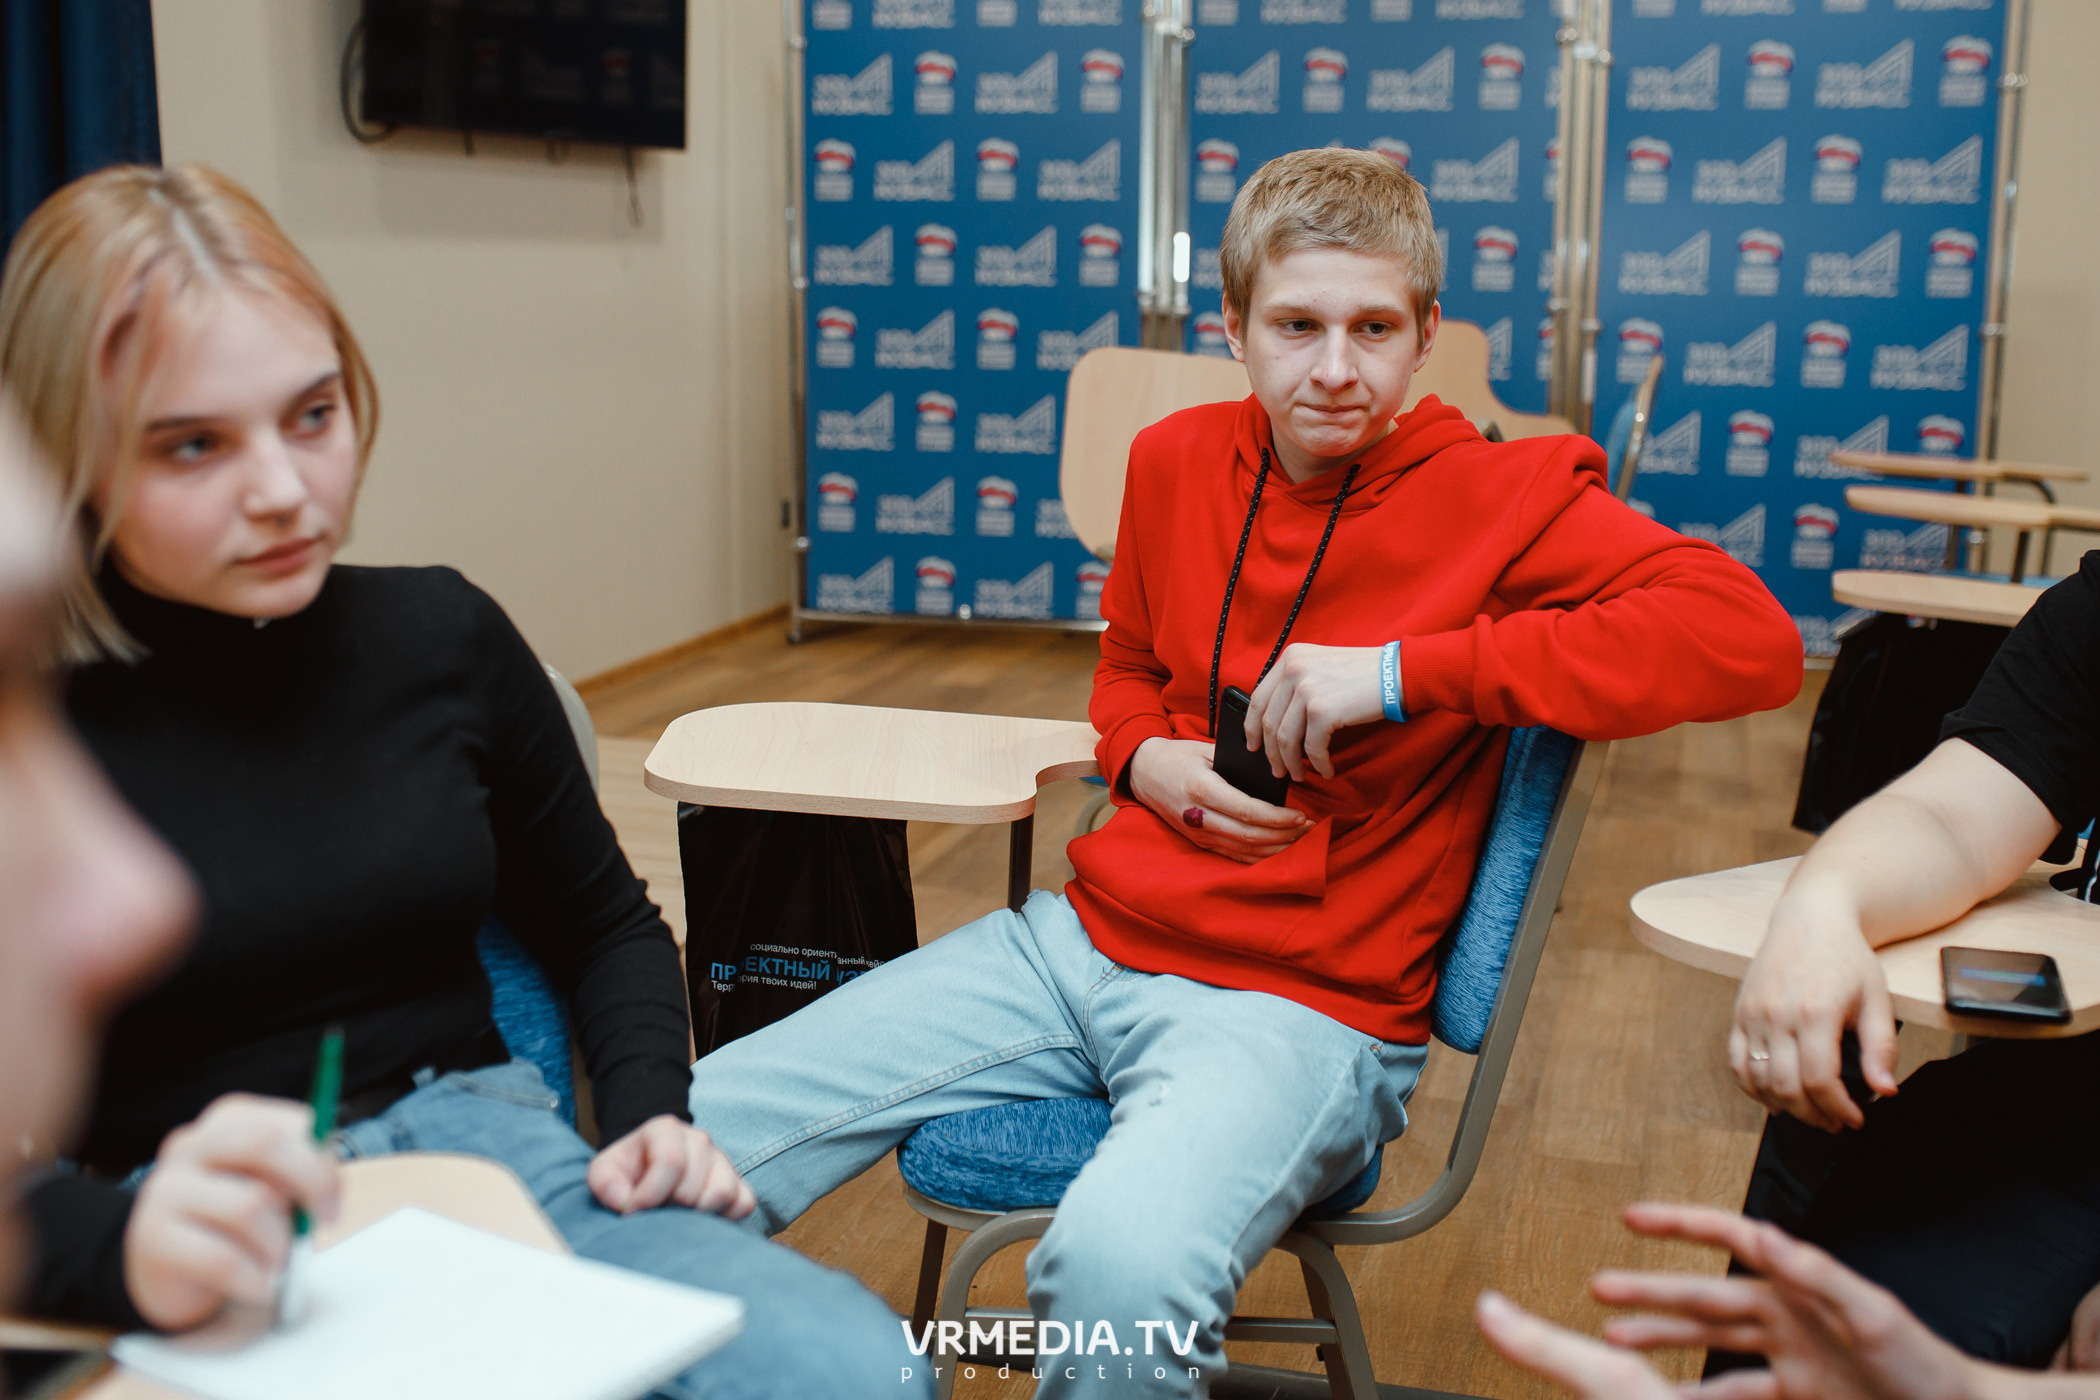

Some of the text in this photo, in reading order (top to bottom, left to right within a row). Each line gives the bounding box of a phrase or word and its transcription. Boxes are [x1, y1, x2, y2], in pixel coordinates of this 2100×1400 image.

[750, 944, 799, 955] социально
[761, 977, 788, 987] твоих
[790, 979, 817, 990] идей!
